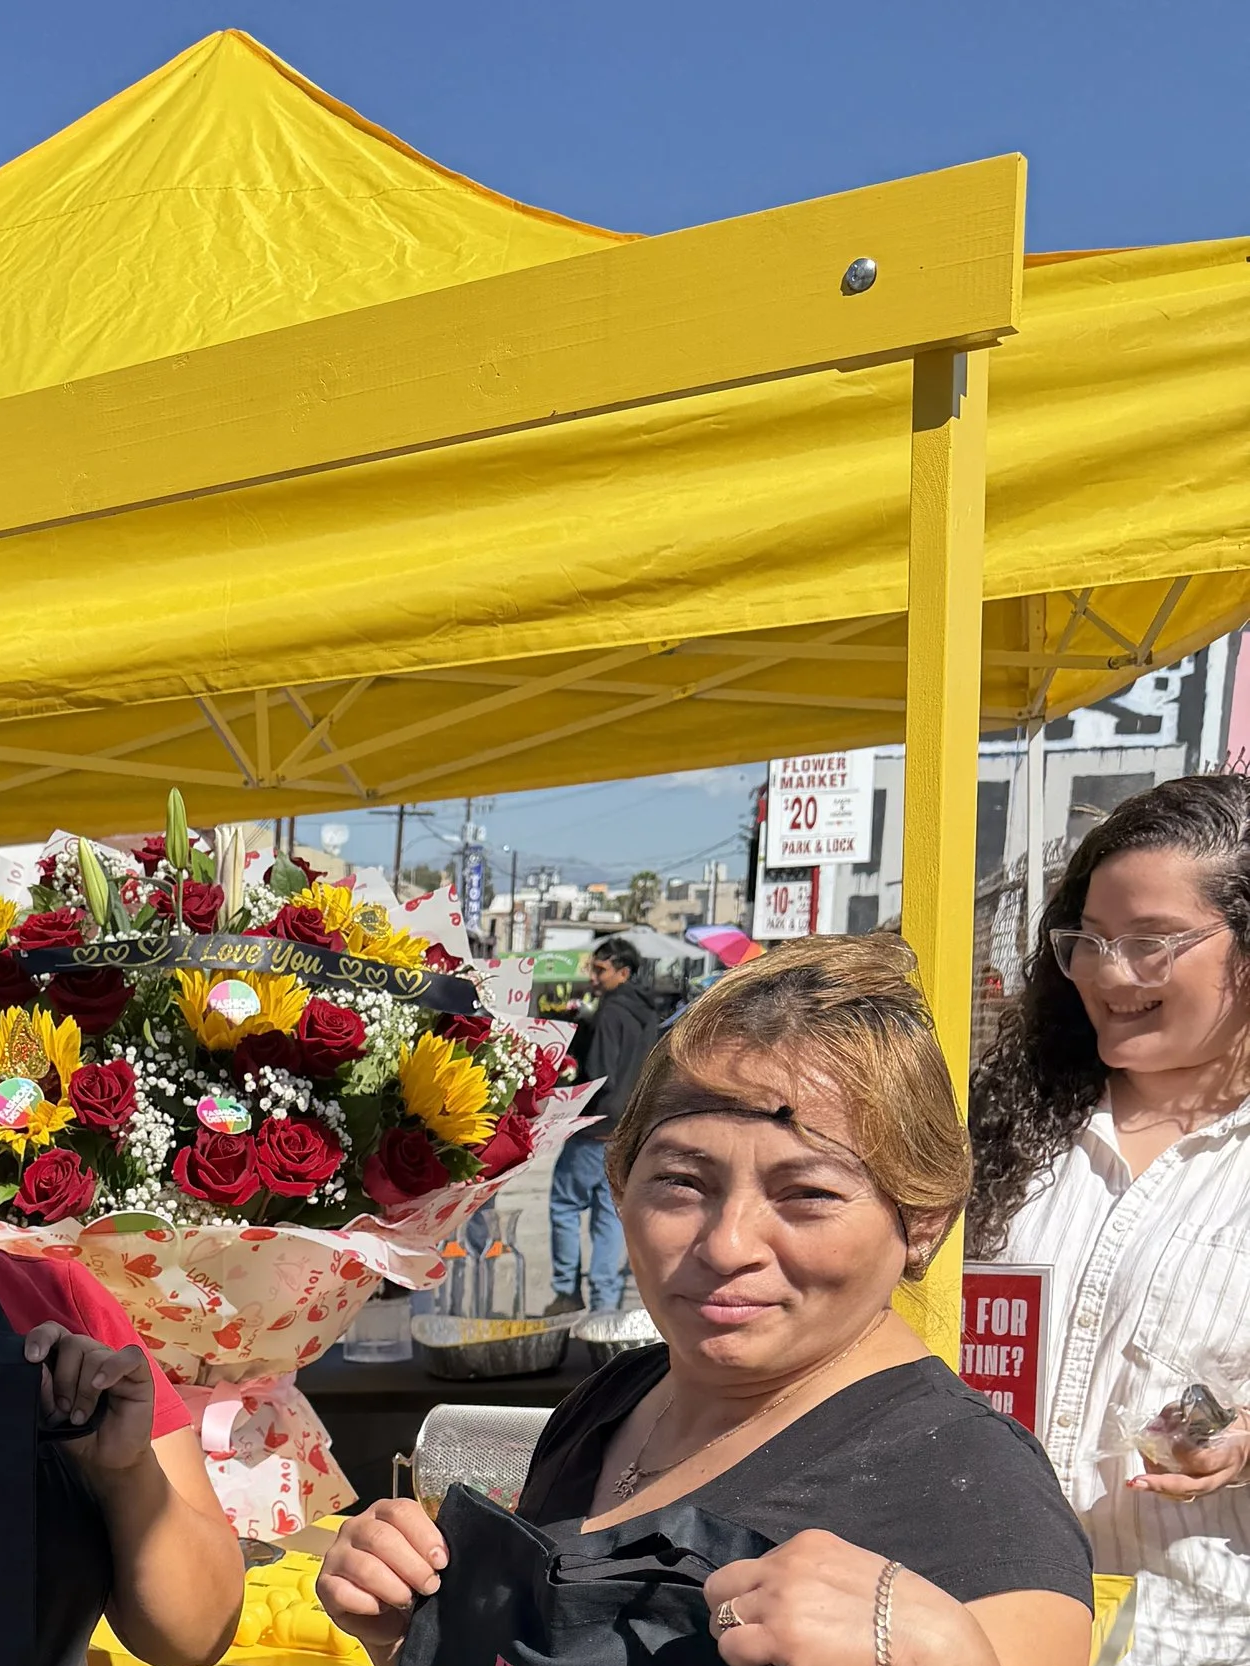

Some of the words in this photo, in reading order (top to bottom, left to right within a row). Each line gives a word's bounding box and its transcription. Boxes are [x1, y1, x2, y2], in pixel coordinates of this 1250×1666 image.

[782, 756, 847, 773] FLOWER
[780, 773, 847, 790] MARKET
[781, 840, 811, 855] PARK
[815, 839, 823, 853] &
[826, 837, 856, 852] LOCK
[175, 934, 195, 963] I
[200, 935, 264, 964] Love
[266, 940, 324, 974] You
[186, 1267, 223, 1296] LOVE
[976, 1297, 1028, 1337] FOR
[959, 1343, 1025, 1378] TINE?
